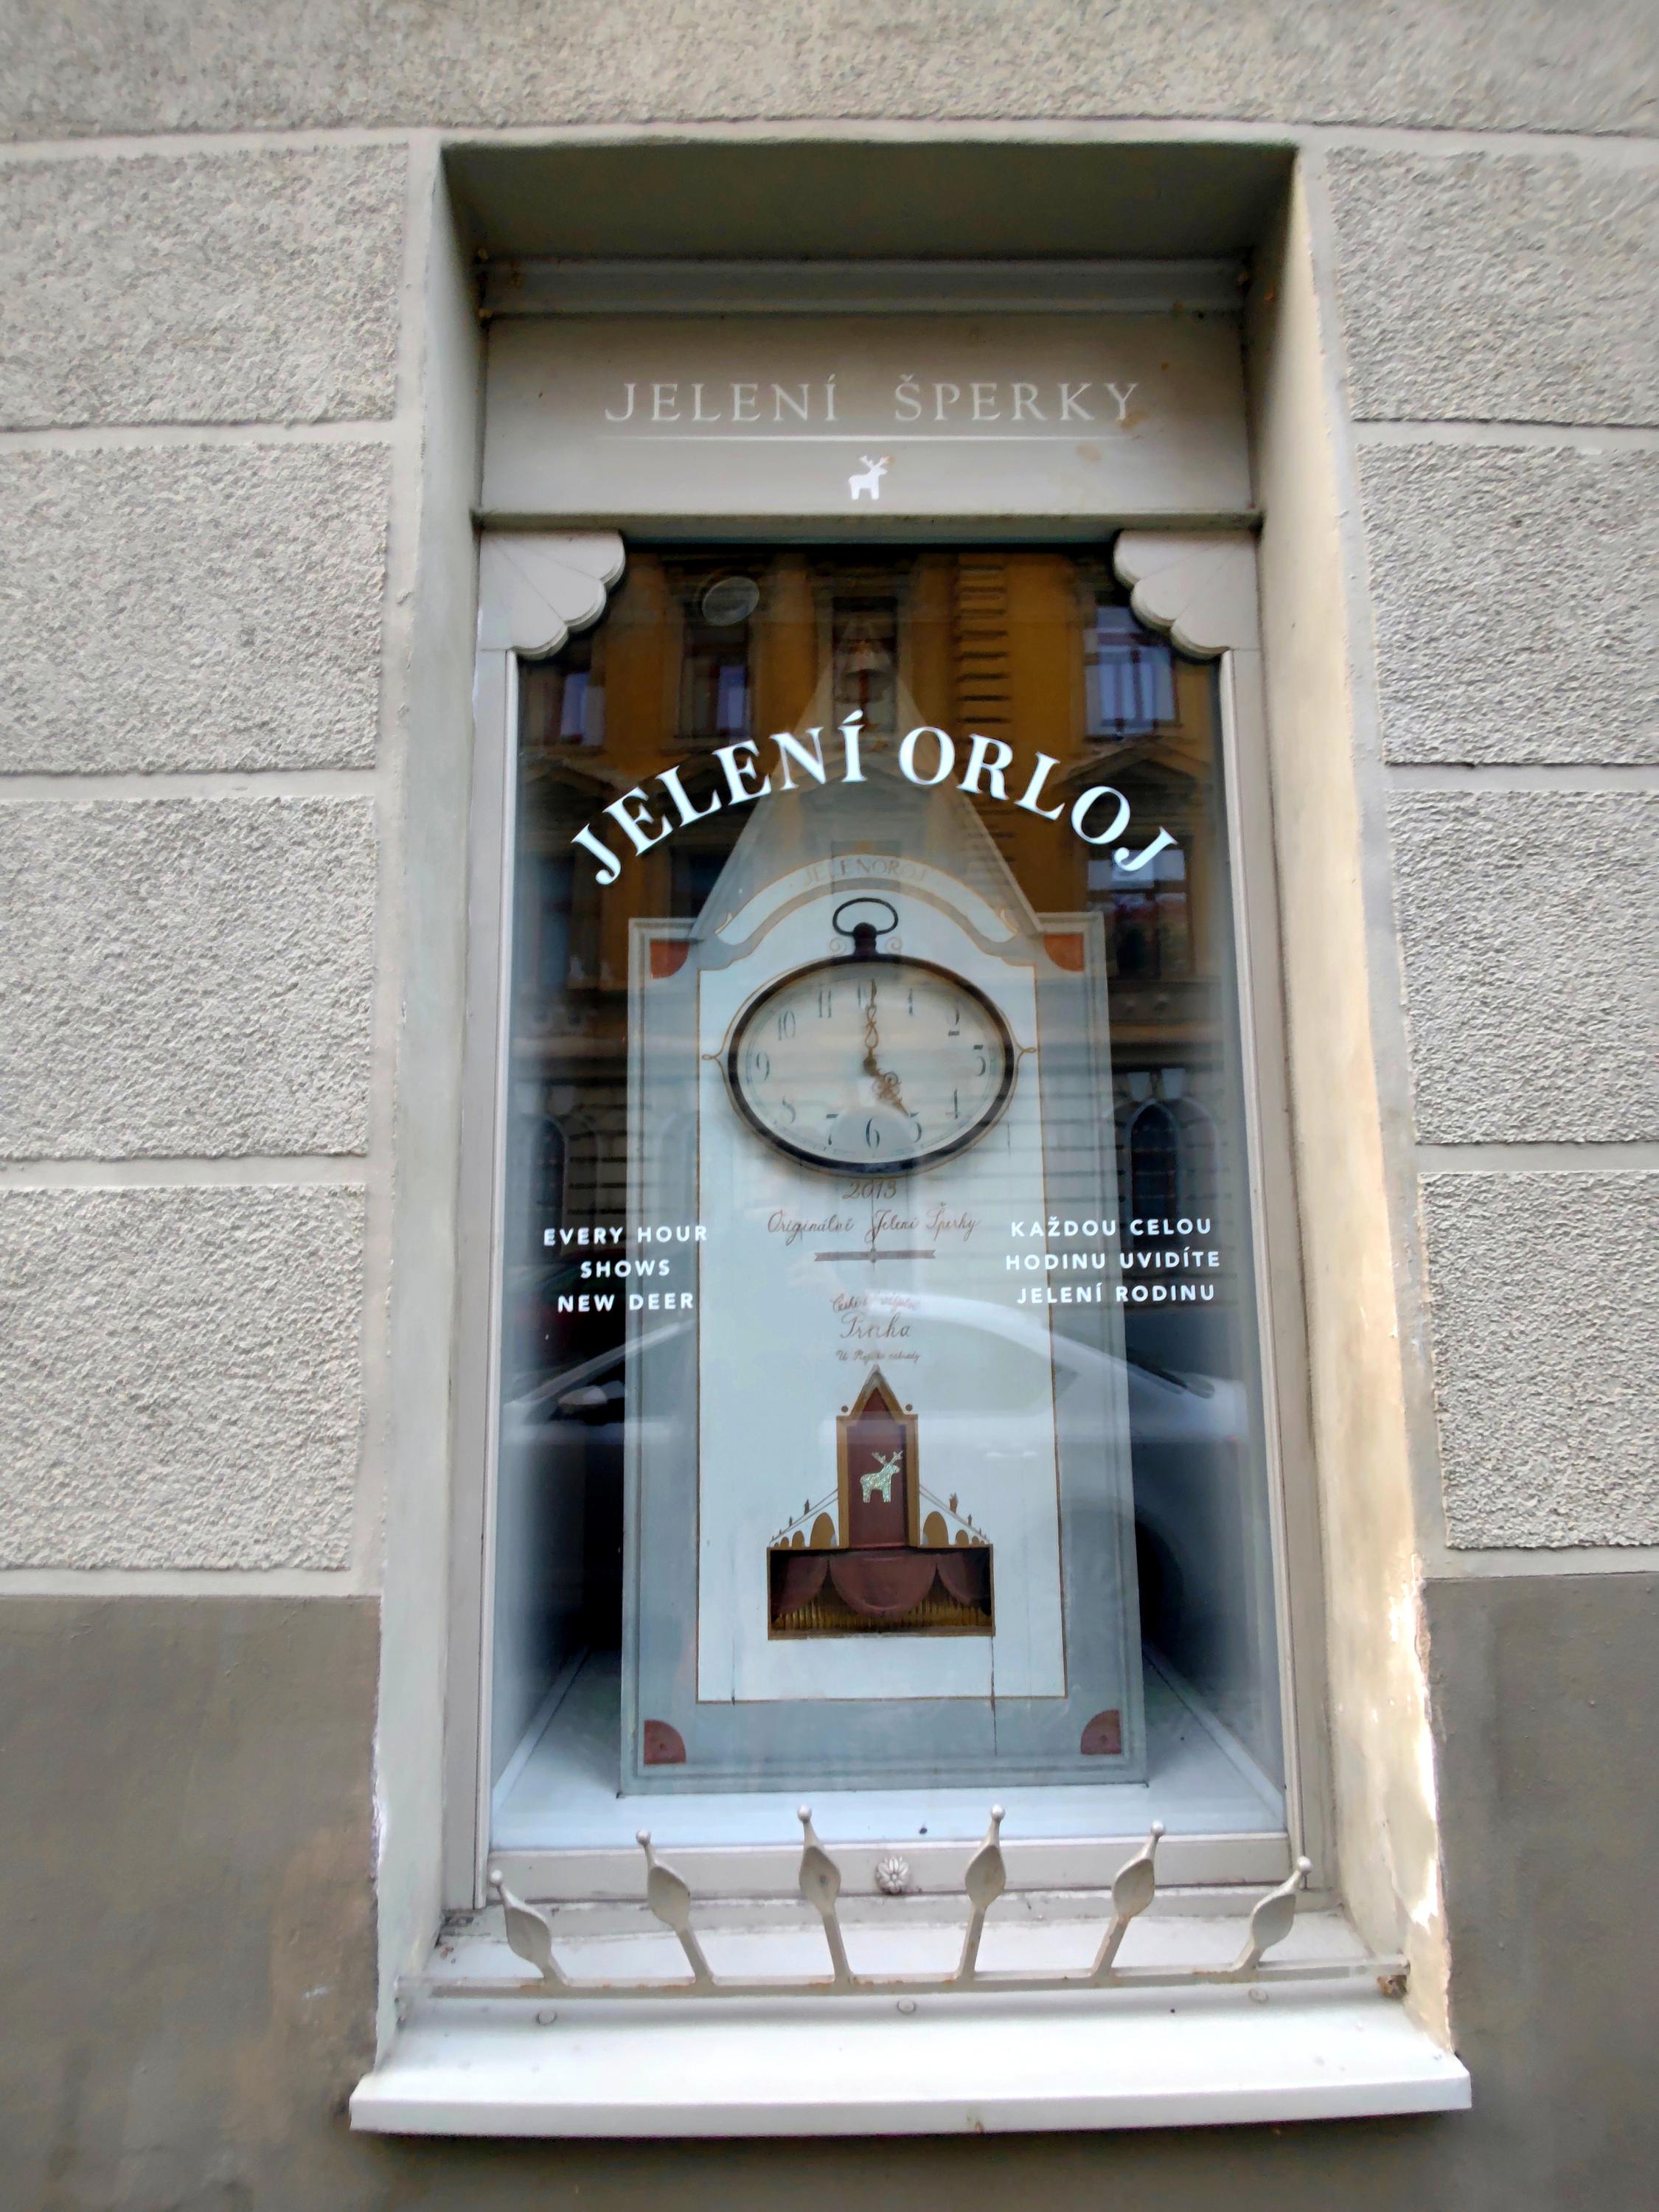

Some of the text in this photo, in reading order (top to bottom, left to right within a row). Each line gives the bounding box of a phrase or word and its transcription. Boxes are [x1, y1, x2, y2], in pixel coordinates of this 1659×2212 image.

[605, 374, 1139, 422] JELENÍ ŠPERKY
[571, 709, 1178, 886] JELENÍ ORLOJ
[777, 1010, 796, 1041] 10
[756, 1052, 771, 1081] 9
[866, 1117, 881, 1150] 6
[842, 1181, 897, 1200] 2013
[543, 1225, 708, 1246] EVERY HOUR
[1011, 1216, 1211, 1237] KAŽDOU CELOU
[580, 1259, 671, 1279] SHOWS
[1006, 1246, 1220, 1270] HODINU UVIDÍTE
[557, 1292, 694, 1313] NEW DEER
[1016, 1282, 1215, 1304] JELENÍ RODINU
[840, 1311, 911, 1339] Praha
